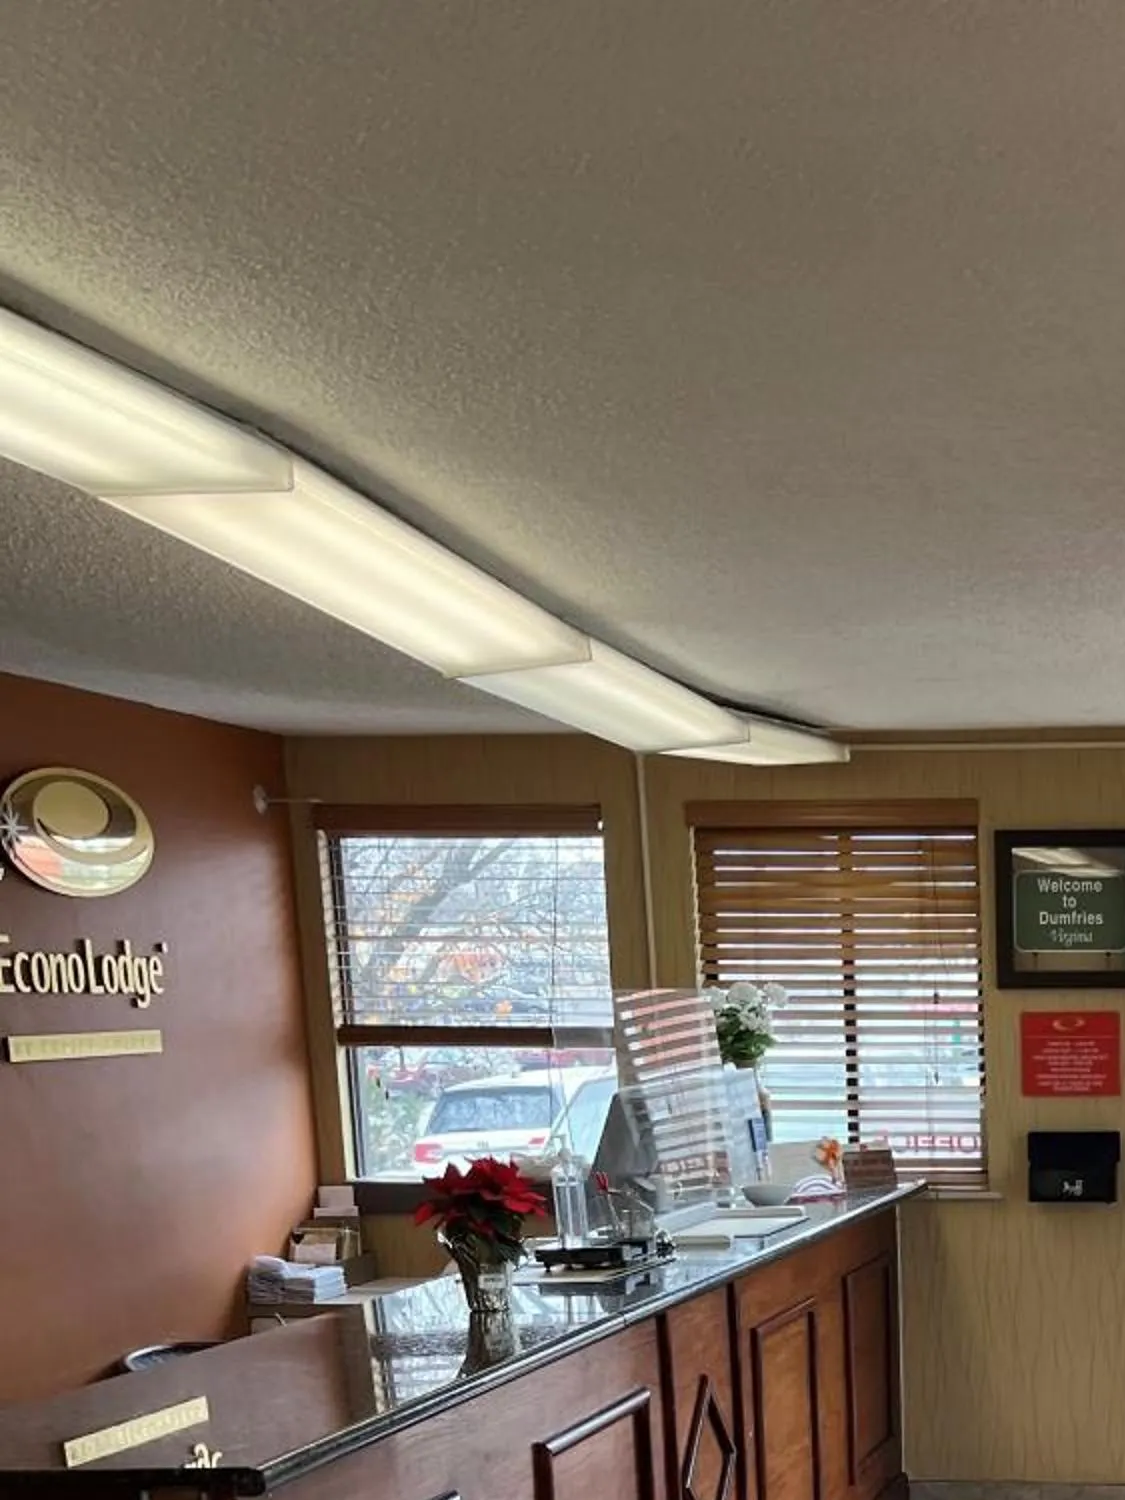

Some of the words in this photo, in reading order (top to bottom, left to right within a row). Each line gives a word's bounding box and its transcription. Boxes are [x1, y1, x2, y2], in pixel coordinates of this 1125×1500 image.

[1036, 877, 1103, 893] Welcome
[1062, 895, 1077, 908] to
[1039, 910, 1104, 925] Dumfries
